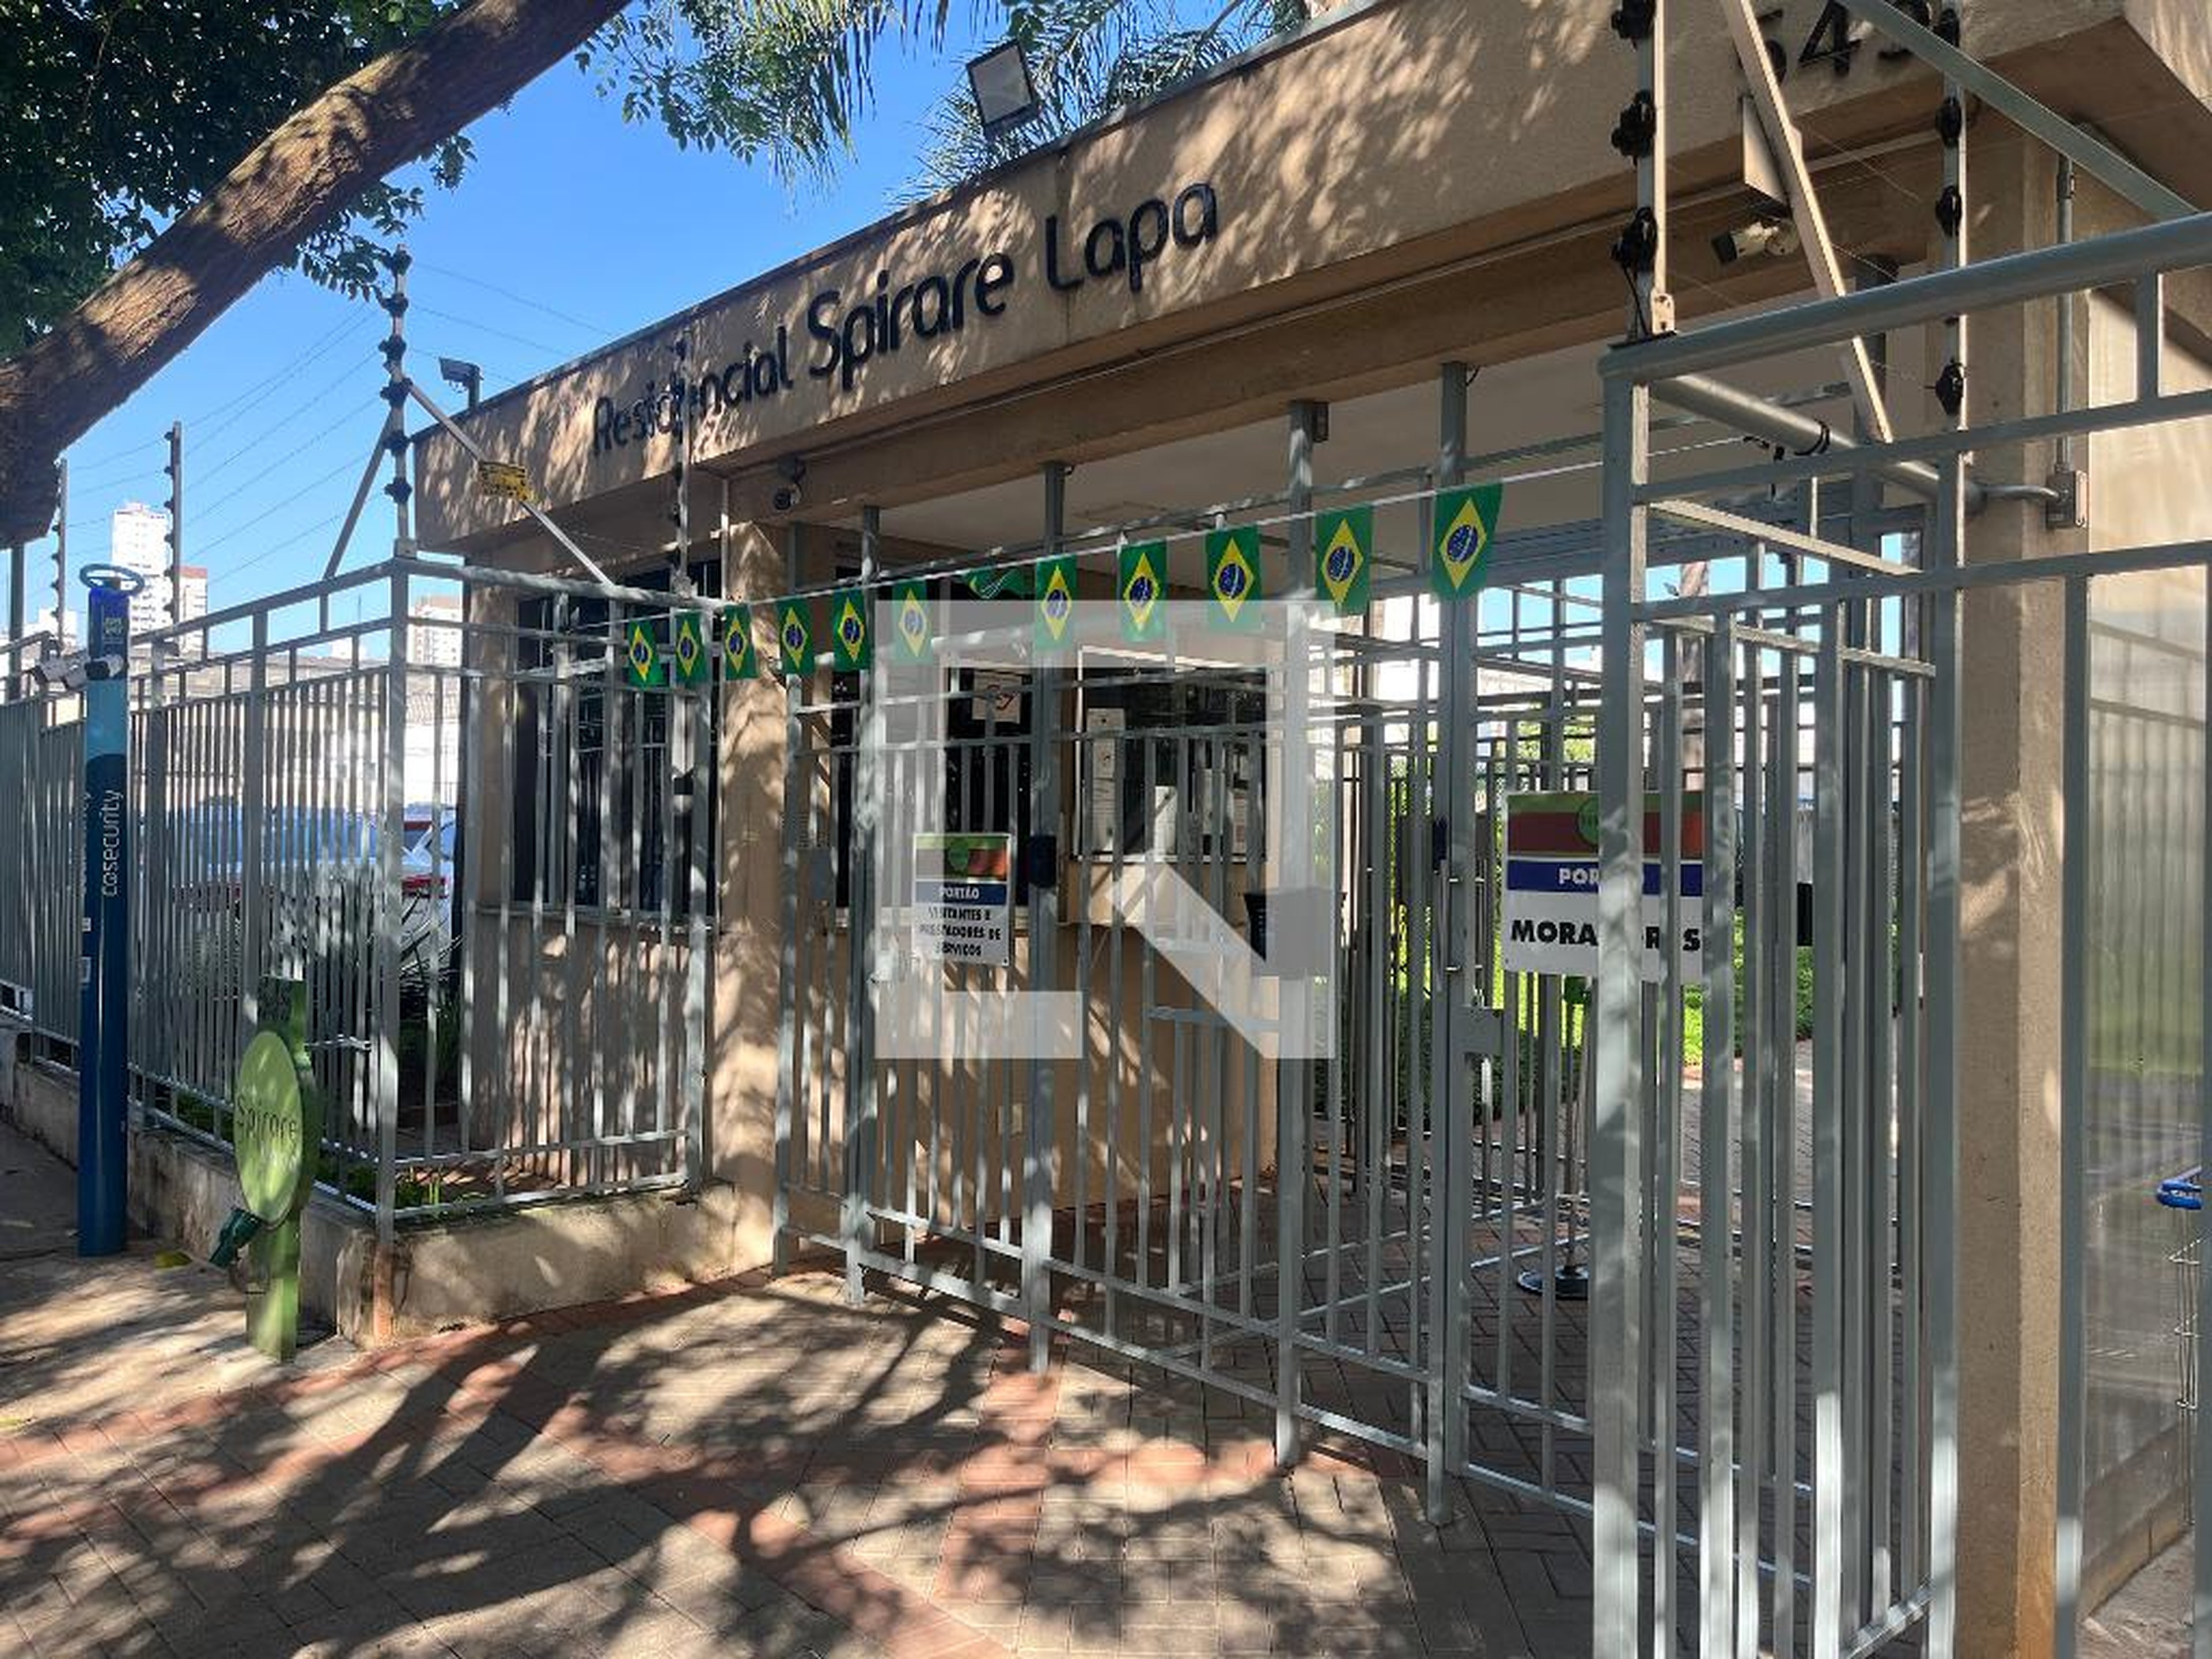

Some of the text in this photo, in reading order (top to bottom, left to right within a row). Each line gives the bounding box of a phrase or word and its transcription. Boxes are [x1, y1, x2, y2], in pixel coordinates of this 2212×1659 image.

[809, 252, 1013, 391] Spirare
[1044, 183, 1218, 291] Lapa
[988, 928, 1001, 941] DE
[1510, 919, 1700, 952] MORARS
[236, 1094, 297, 1140] Spirare
